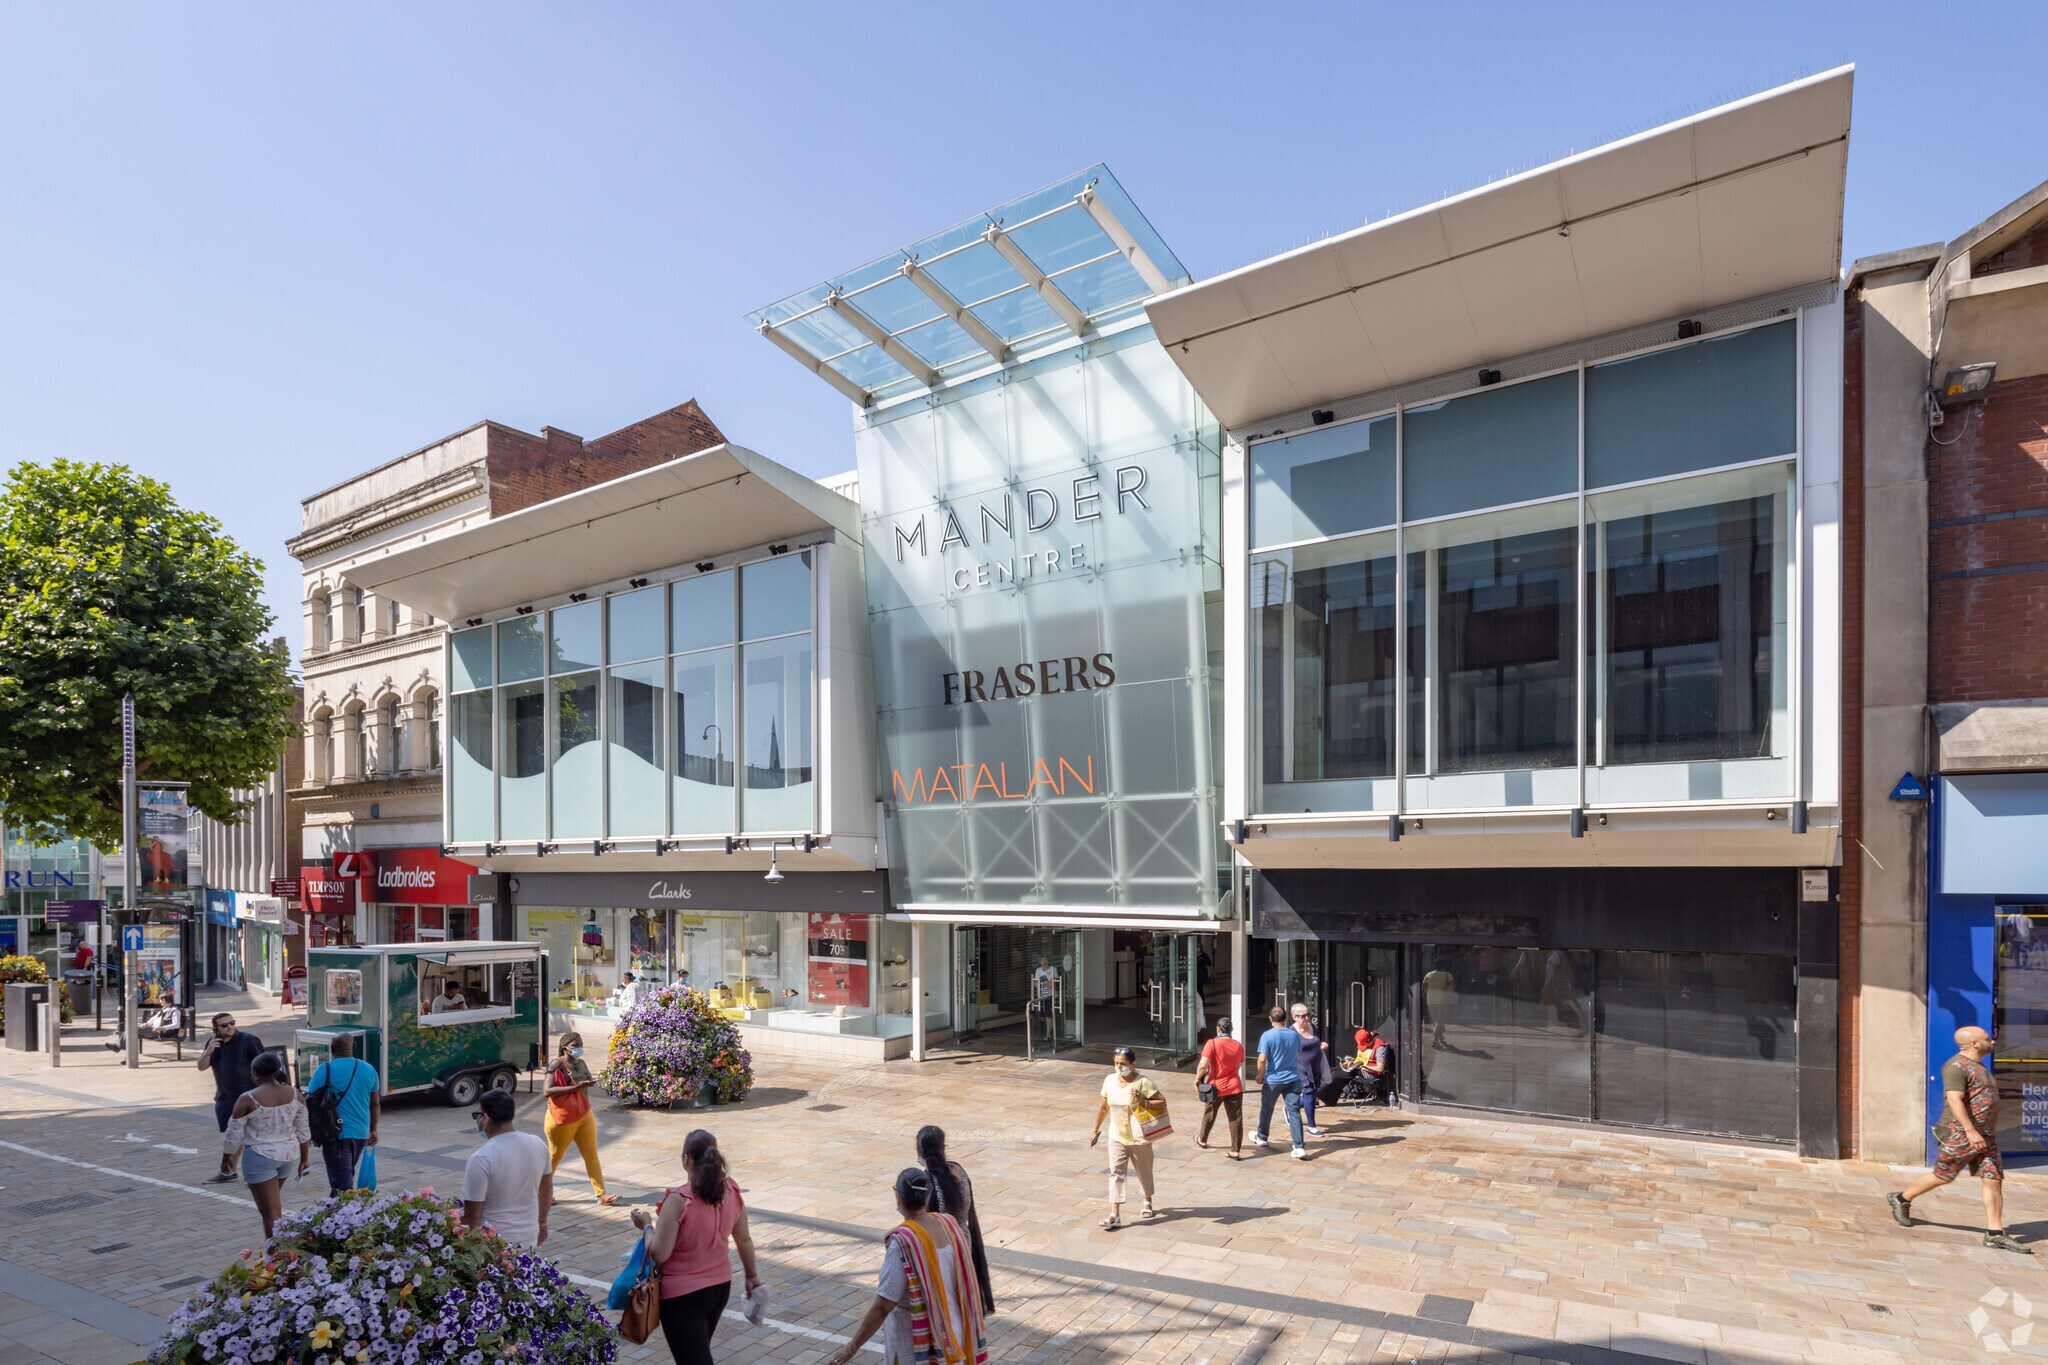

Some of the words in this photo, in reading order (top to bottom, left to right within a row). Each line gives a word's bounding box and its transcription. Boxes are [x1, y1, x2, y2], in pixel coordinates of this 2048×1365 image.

[893, 464, 1151, 561] MANDER
[953, 543, 1086, 590] CENTRE
[942, 652, 1116, 705] FRASERS
[893, 755, 1094, 803] MATALAN
[4, 870, 74, 888] RUN
[308, 881, 345, 893] TIMPSON
[378, 866, 436, 888] Ladbrokes
[649, 881, 691, 899] Clarks
[823, 928, 852, 940] SALE
[830, 944, 845, 955] 70%
